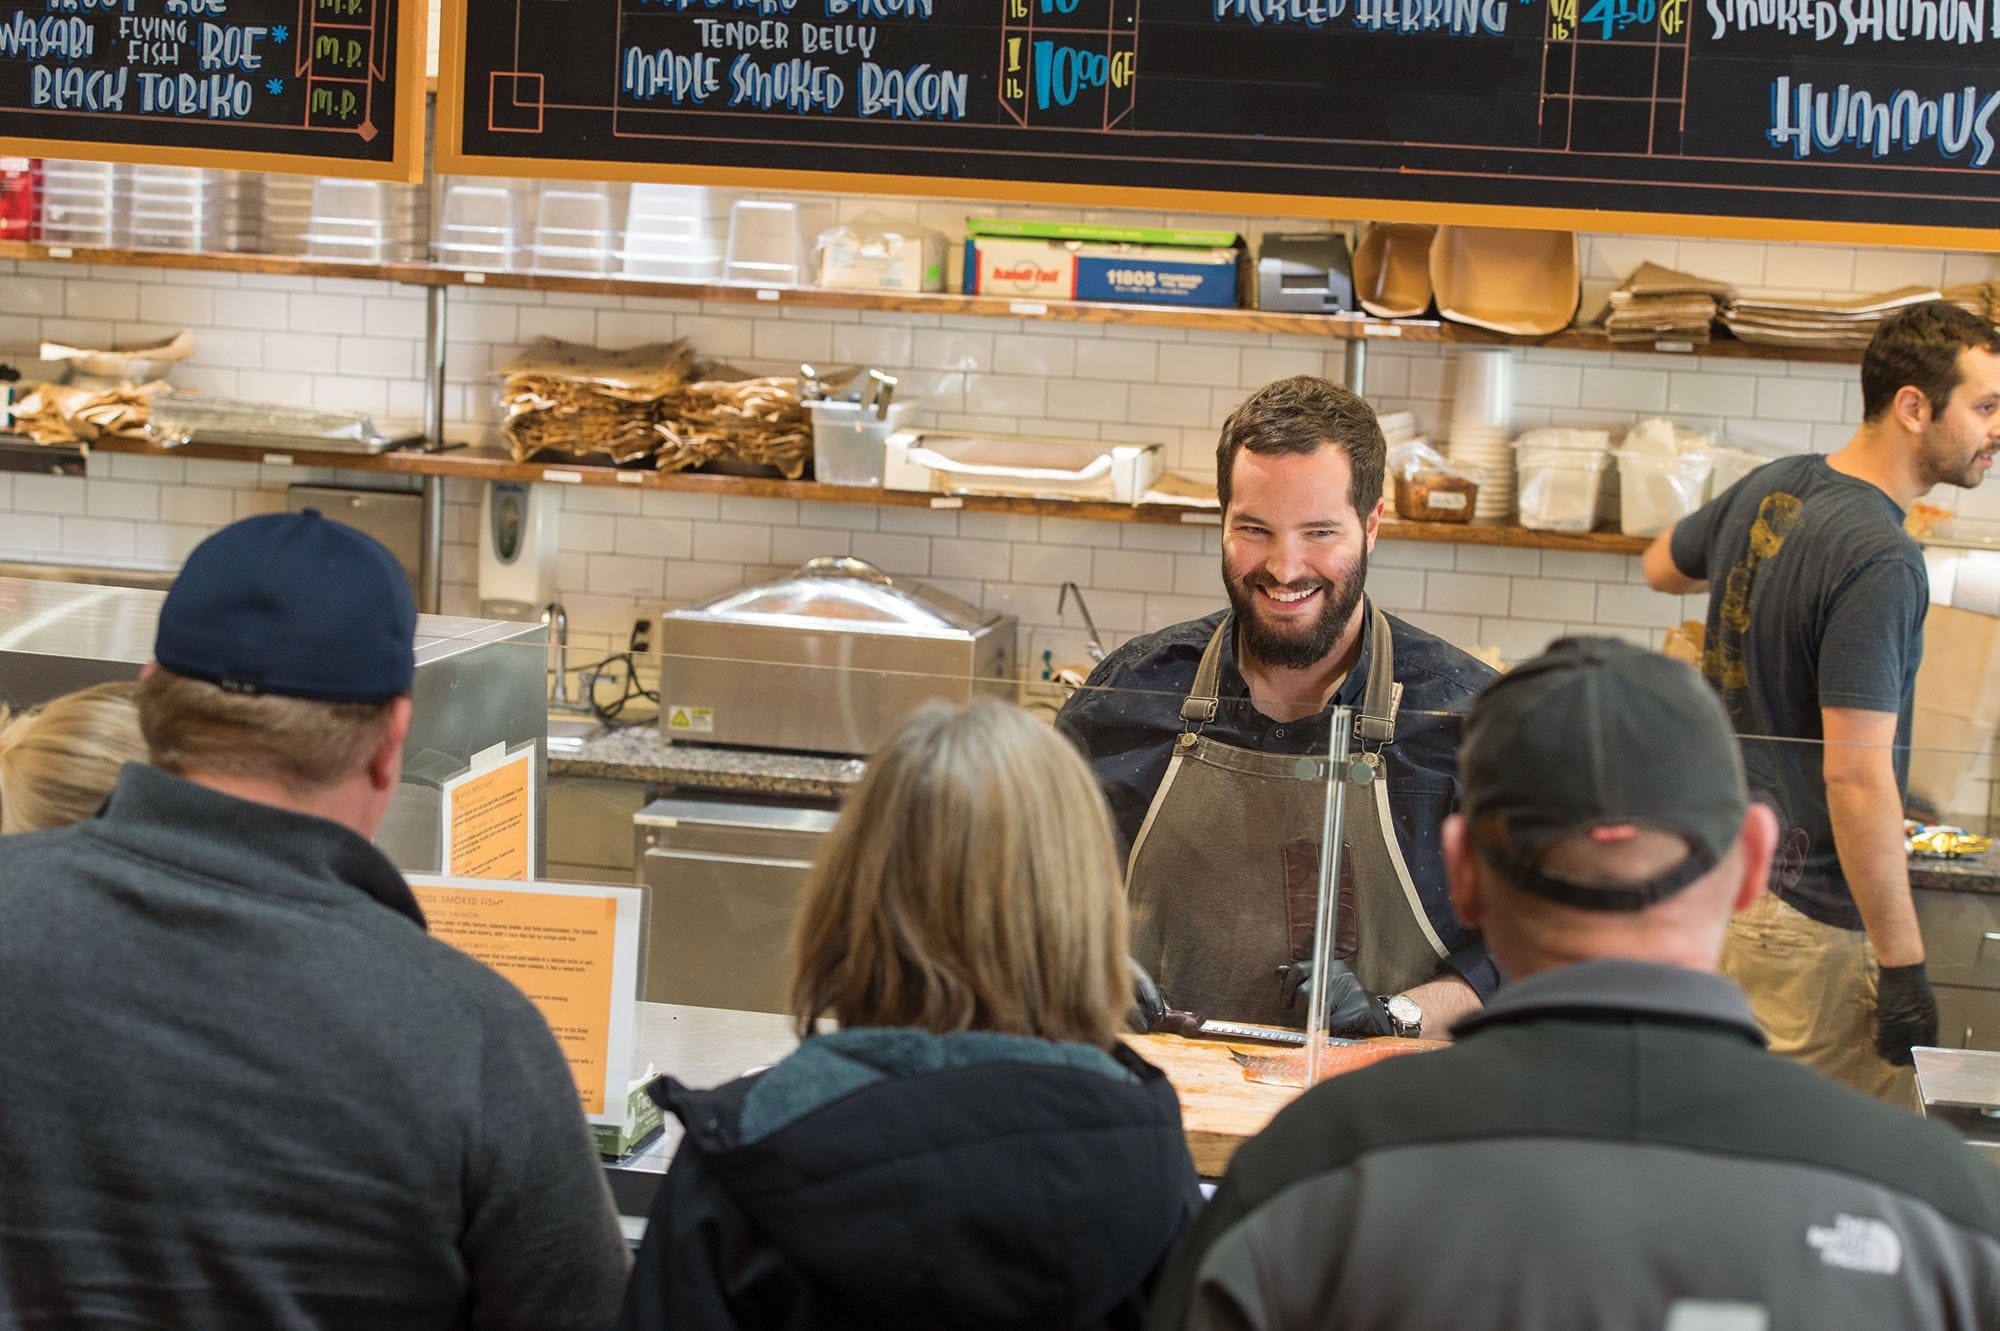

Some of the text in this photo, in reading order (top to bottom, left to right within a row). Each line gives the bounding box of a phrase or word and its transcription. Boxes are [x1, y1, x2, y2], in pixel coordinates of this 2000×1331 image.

[1552, 22, 1569, 40] lb
[1660, 0, 1688, 35] GF
[1706, 0, 1838, 41] SMOKED
[1838, 0, 1984, 45] SALMON
[0, 10, 268, 70] WASABI FLYING FISH ROE
[693, 19, 876, 58] TENDER BELLY
[622, 45, 969, 121] MAPLE SMOKED BACON
[1006, 78, 1024, 99] lb
[1110, 51, 1135, 89] GF
[31, 64, 253, 119] BLACK TOBIKO
[1766, 75, 2000, 168] HUMMUS
[1106, 268, 1156, 287] 11805
